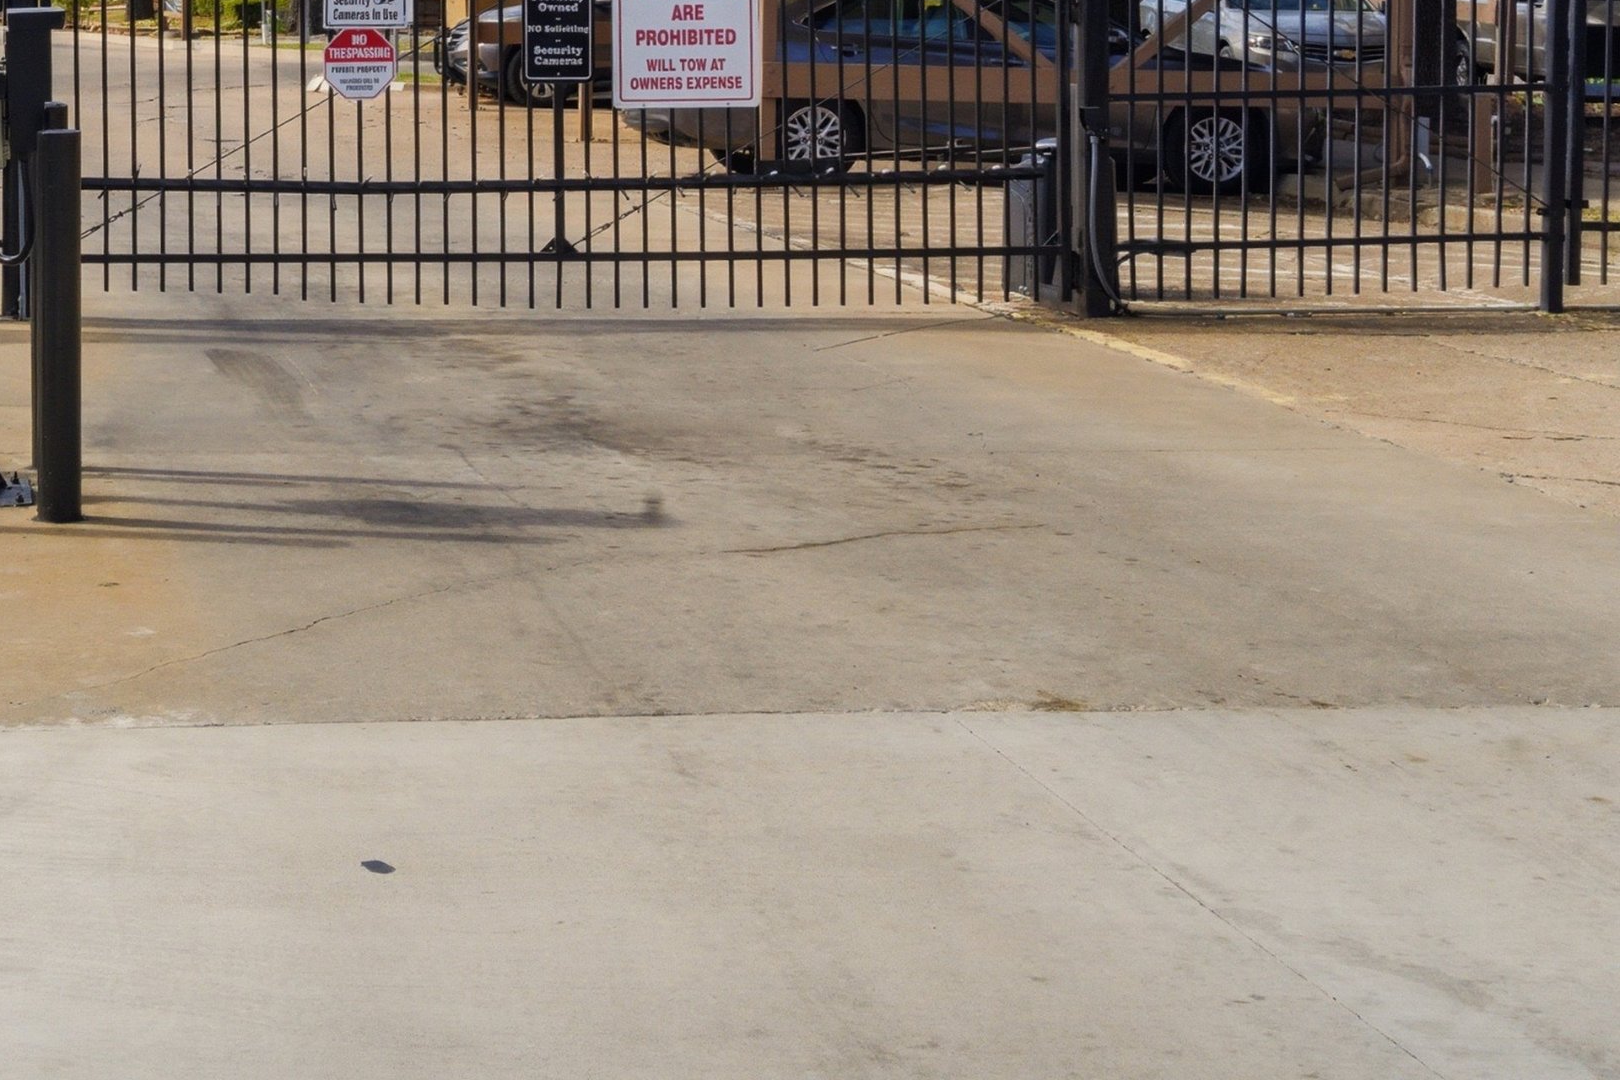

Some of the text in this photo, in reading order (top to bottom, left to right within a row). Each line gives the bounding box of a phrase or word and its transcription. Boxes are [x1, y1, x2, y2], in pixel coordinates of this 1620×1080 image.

[538, 3, 578, 12] Owned
[671, 5, 704, 20] ARE
[333, 9, 398, 20] Cameras In Use
[544, 25, 589, 34] Soliciting
[352, 34, 367, 45] NO
[636, 29, 736, 45] PROHIBITED
[328, 48, 390, 58] TRESPASSING
[534, 45, 583, 55] Security
[534, 57, 583, 65] Cameras
[647, 58, 726, 71] WILL TOW AT
[630, 76, 742, 90] OWNERS EXPENSE
